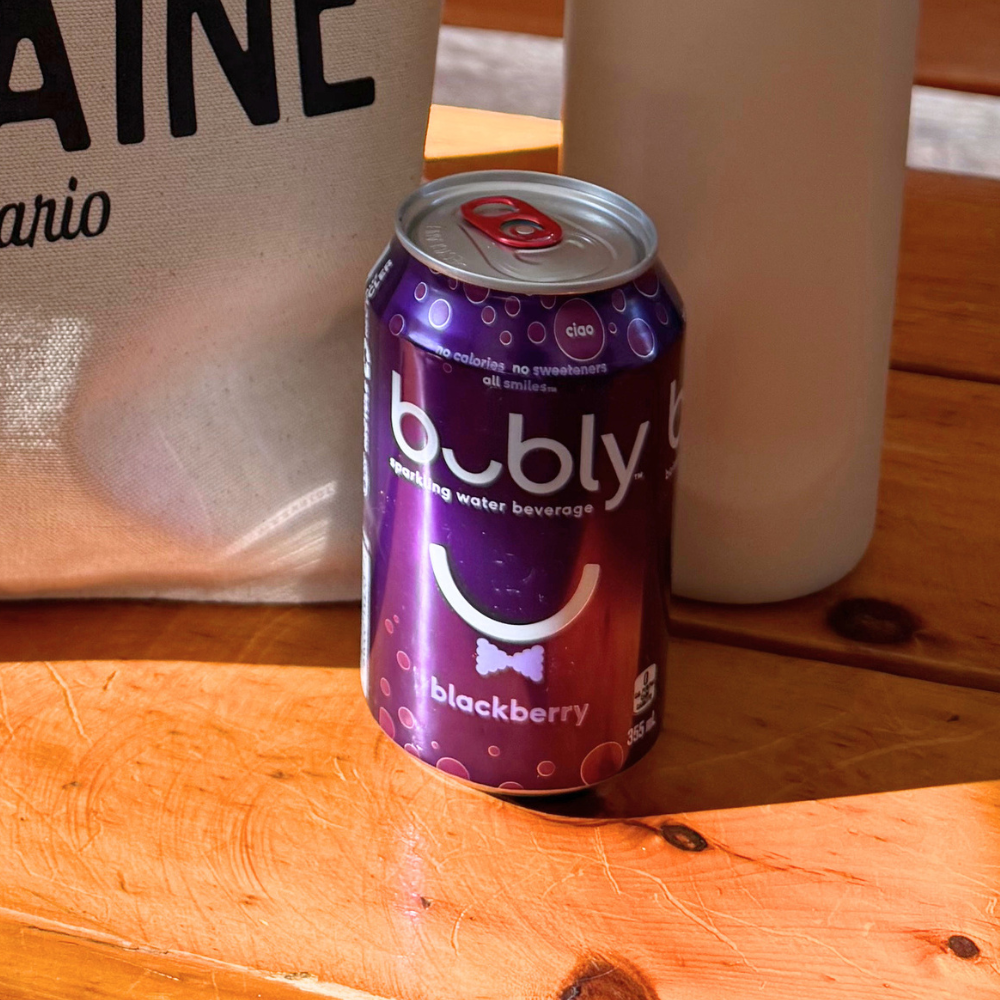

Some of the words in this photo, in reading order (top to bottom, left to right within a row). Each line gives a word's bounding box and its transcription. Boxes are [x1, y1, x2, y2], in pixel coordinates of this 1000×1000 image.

[565, 322, 594, 338] ciao
[435, 346, 450, 358] no
[453, 352, 505, 372] calories
[512, 364, 529, 375] no
[533, 363, 607, 376] sweeteners
[482, 375, 500, 388] all
[391, 370, 649, 511] bubly
[389, 456, 451, 500] sparkling
[456, 491, 506, 512] water
[512, 501, 594, 518] beverage
[431, 676, 589, 726] blackberry
[627, 719, 645, 746] 355
